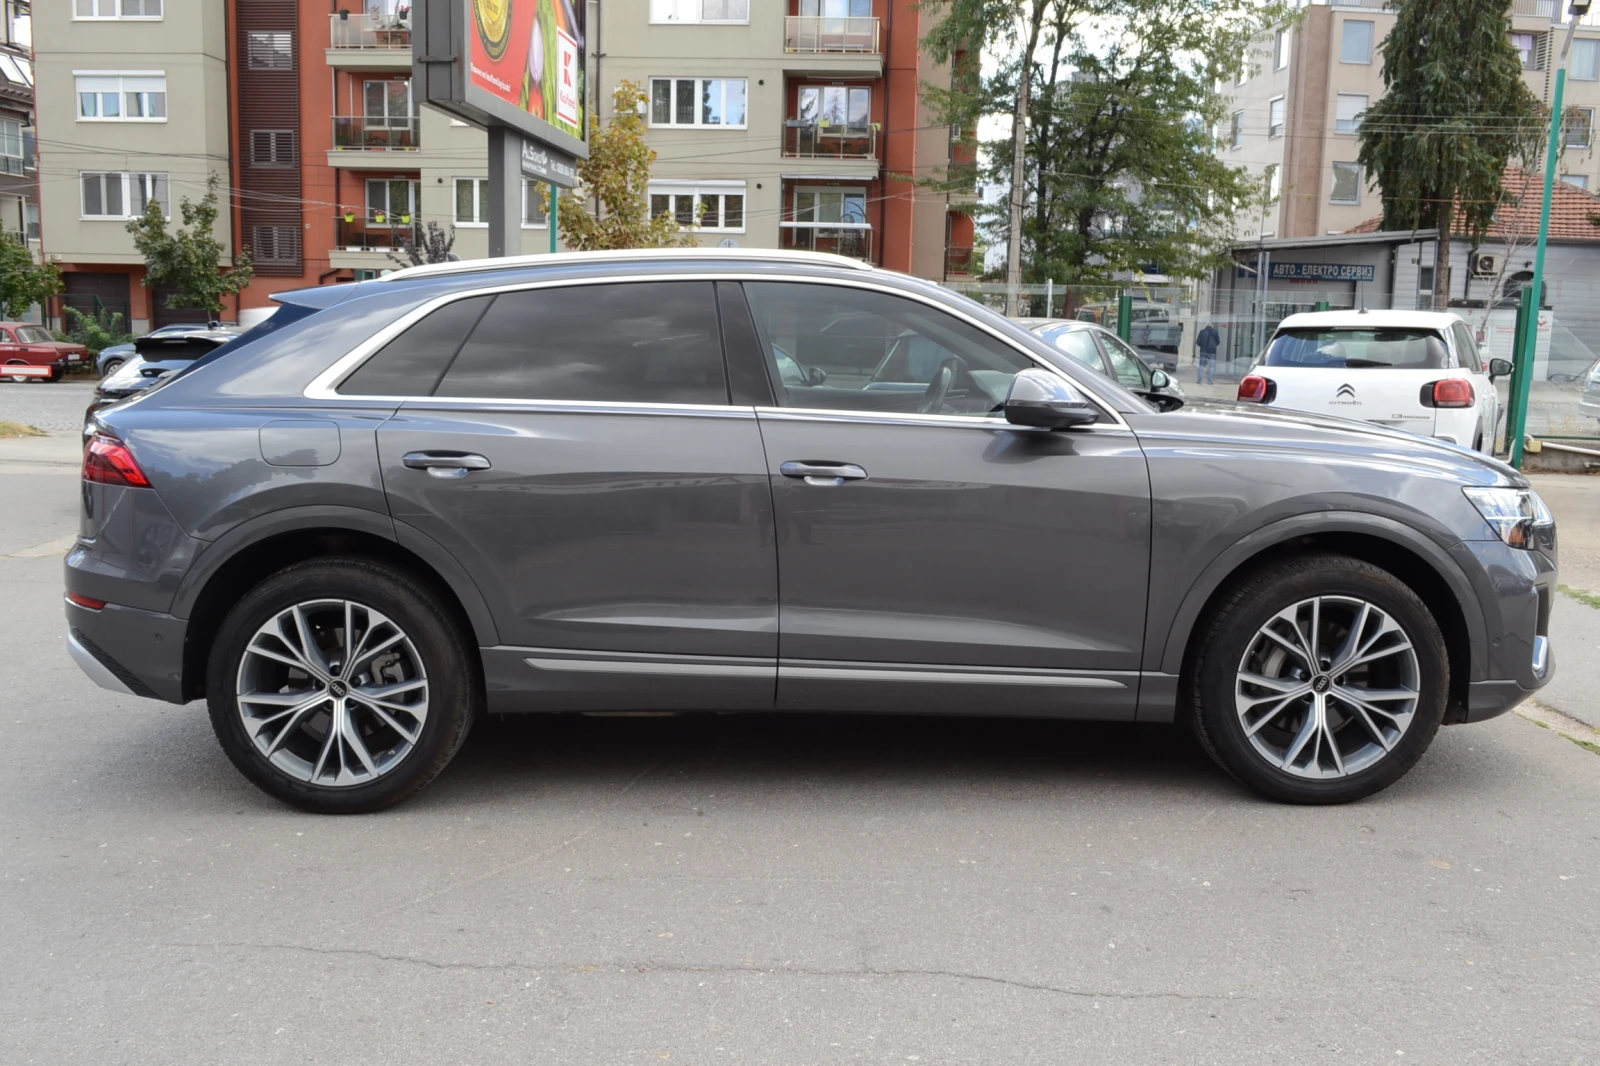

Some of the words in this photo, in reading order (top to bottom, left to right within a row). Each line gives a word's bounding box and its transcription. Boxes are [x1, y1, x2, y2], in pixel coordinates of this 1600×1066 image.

[1273, 264, 1296, 275] АВТО
[1302, 264, 1339, 276] ЕЛЕКТРО
[1341, 265, 1373, 277] СЕРВИЗ
